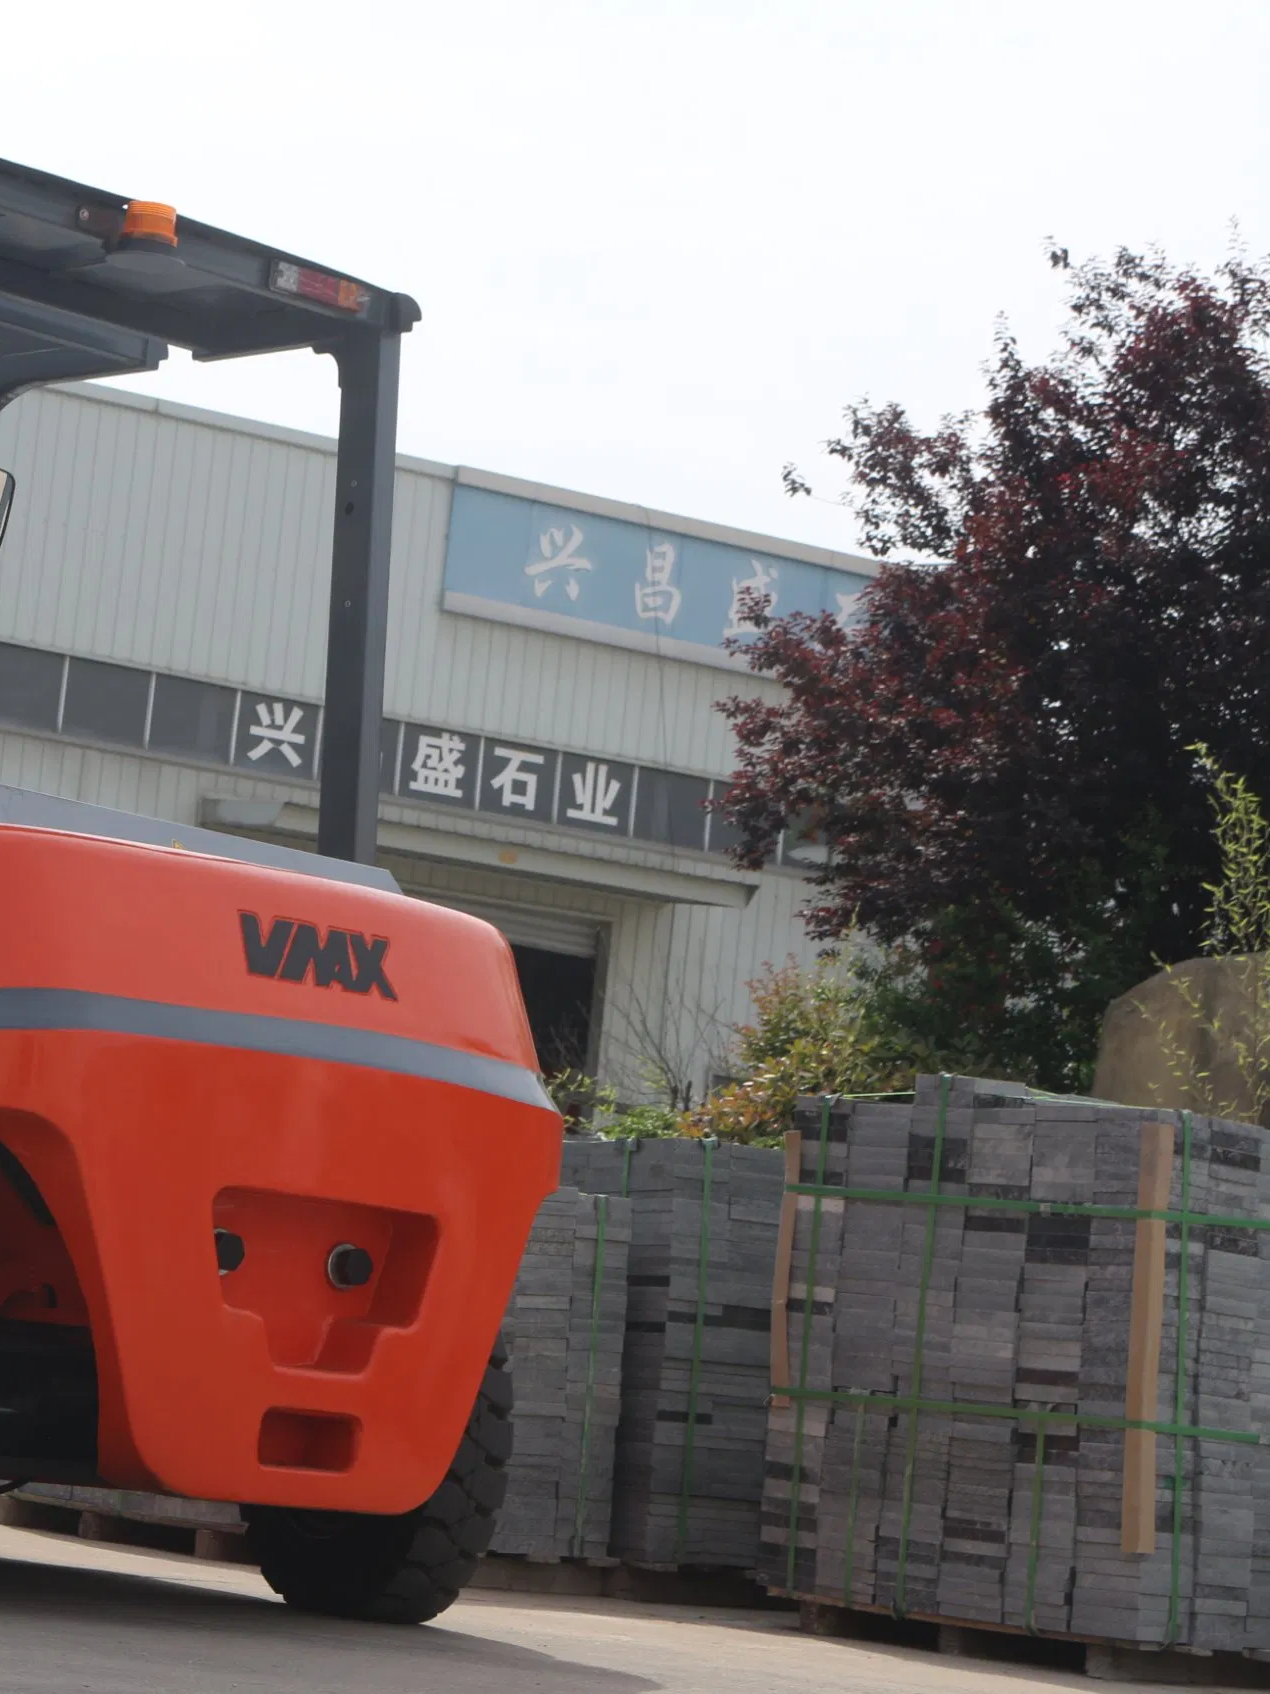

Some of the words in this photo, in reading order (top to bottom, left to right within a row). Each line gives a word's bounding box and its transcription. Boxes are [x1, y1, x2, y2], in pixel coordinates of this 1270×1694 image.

[247, 702, 622, 827] 兴盛石业
[238, 911, 399, 1002] VMAX
